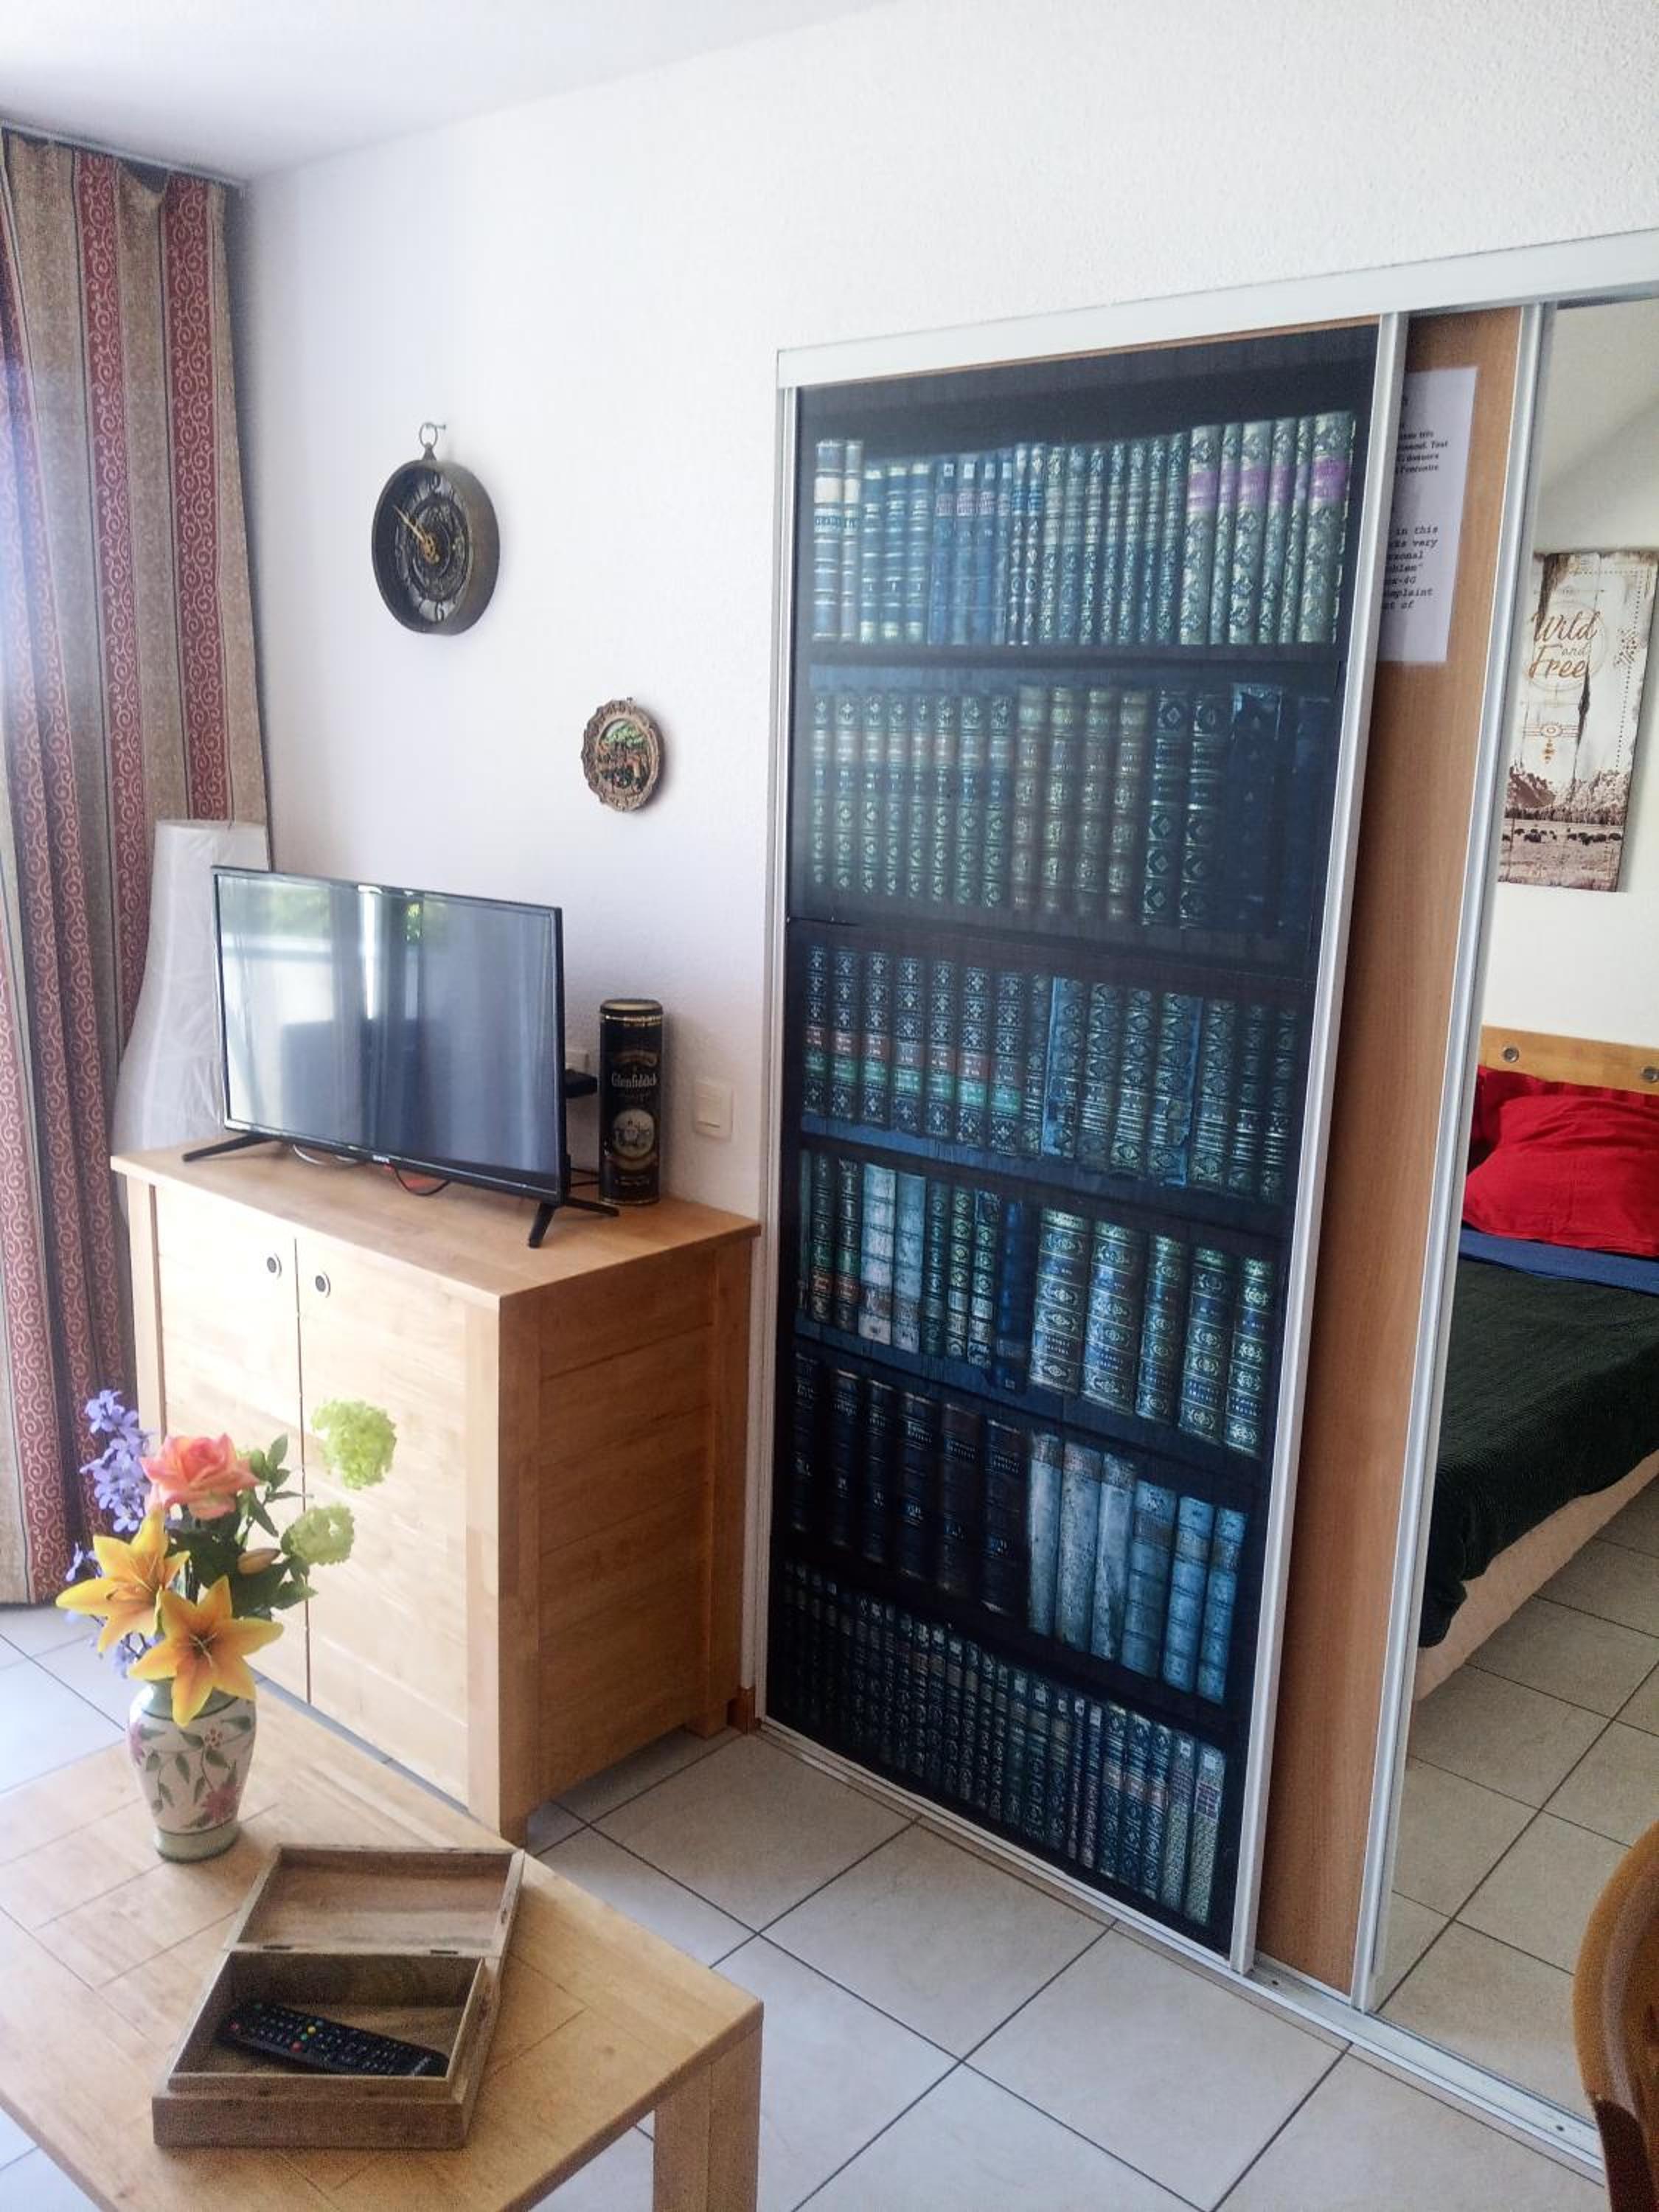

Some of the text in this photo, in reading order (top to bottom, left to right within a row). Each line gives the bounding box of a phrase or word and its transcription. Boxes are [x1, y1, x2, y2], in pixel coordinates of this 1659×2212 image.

[1414, 525, 1438, 535] this
[1412, 539, 1439, 549] very
[1531, 611, 1601, 642] Wild
[1528, 644, 1586, 679] Free
